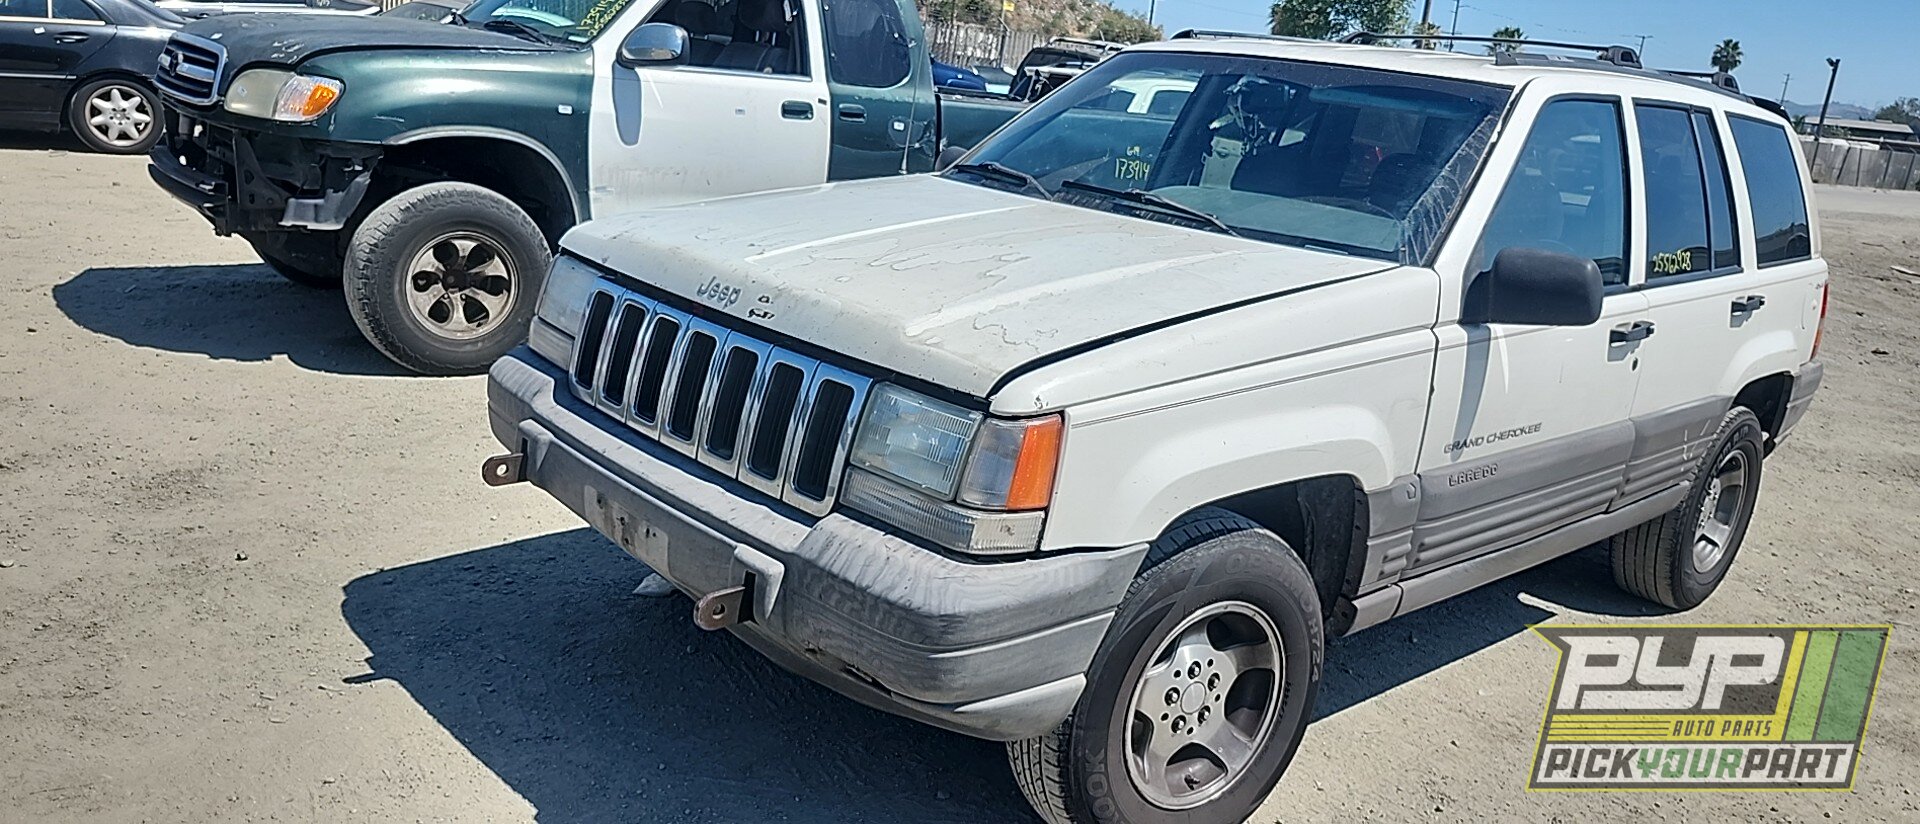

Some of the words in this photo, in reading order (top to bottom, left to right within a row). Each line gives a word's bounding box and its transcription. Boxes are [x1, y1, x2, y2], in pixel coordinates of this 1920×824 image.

[1115, 158, 1150, 181] 173914
[1652, 249, 1692, 274] 25562928
[696, 275, 742, 311] Jeep
[1443, 436, 1485, 454] GRAND
[1486, 422, 1542, 444] CHEROKEE
[1448, 463, 1499, 487] LAREDO
